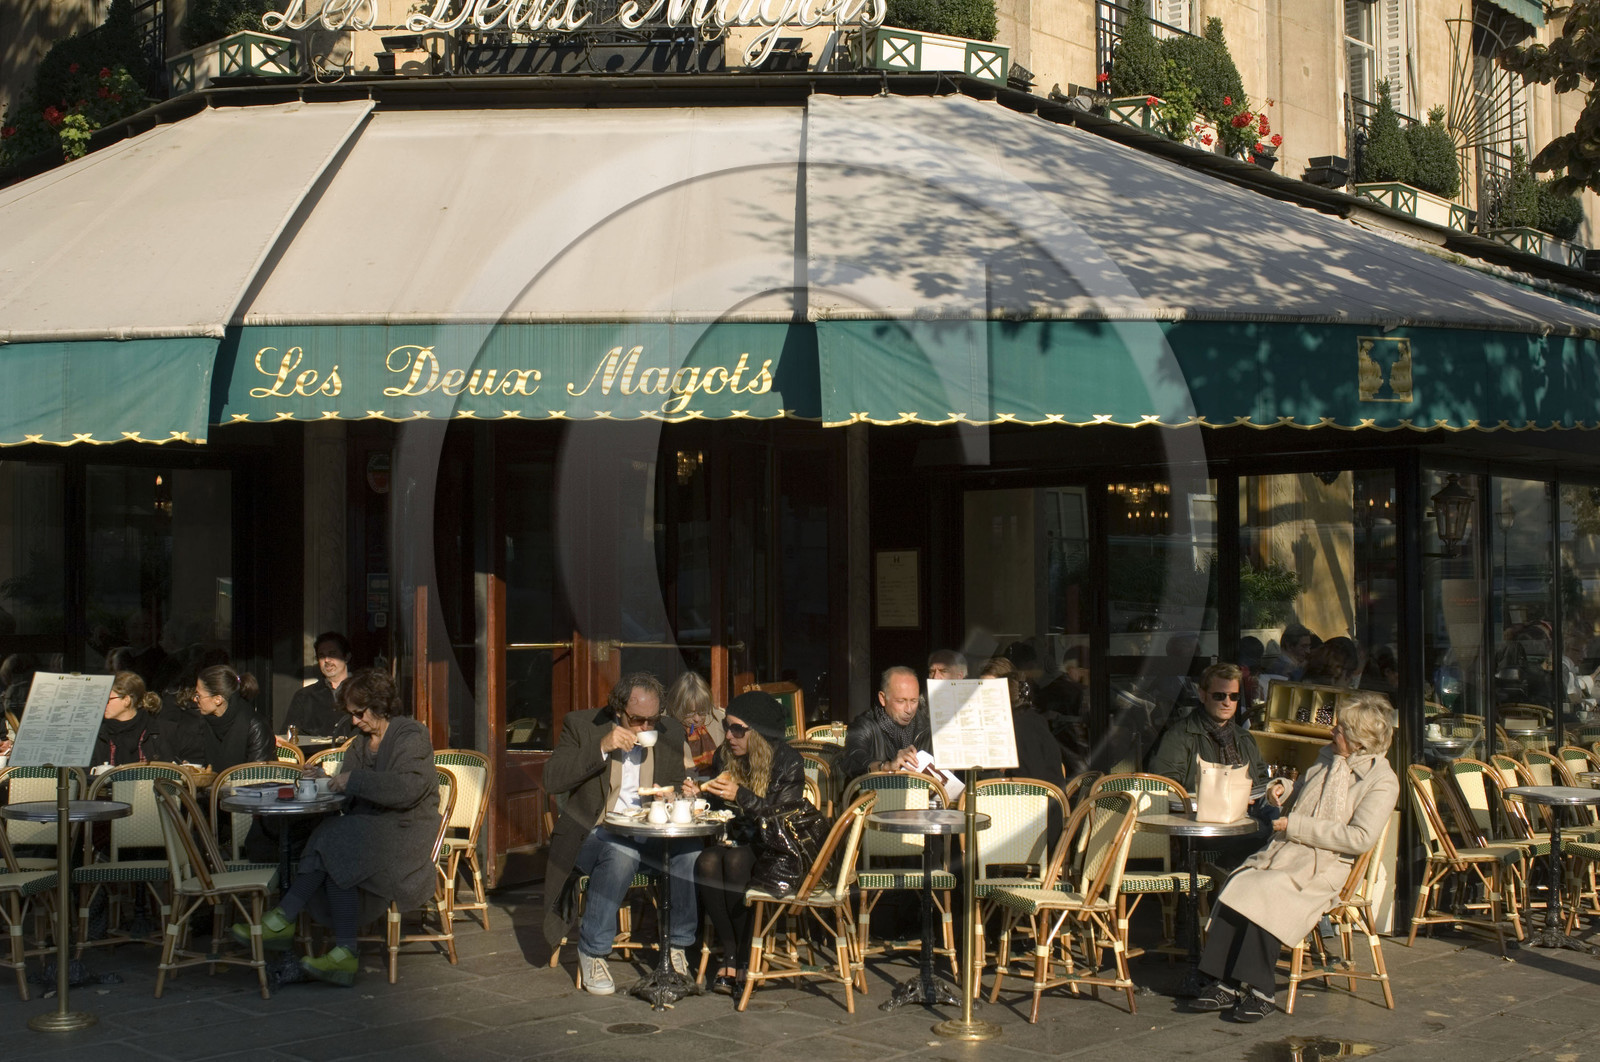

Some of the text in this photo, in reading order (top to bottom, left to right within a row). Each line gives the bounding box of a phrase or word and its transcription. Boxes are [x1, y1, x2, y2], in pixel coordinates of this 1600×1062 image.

[249, 344, 774, 413] Les Deux Magots
